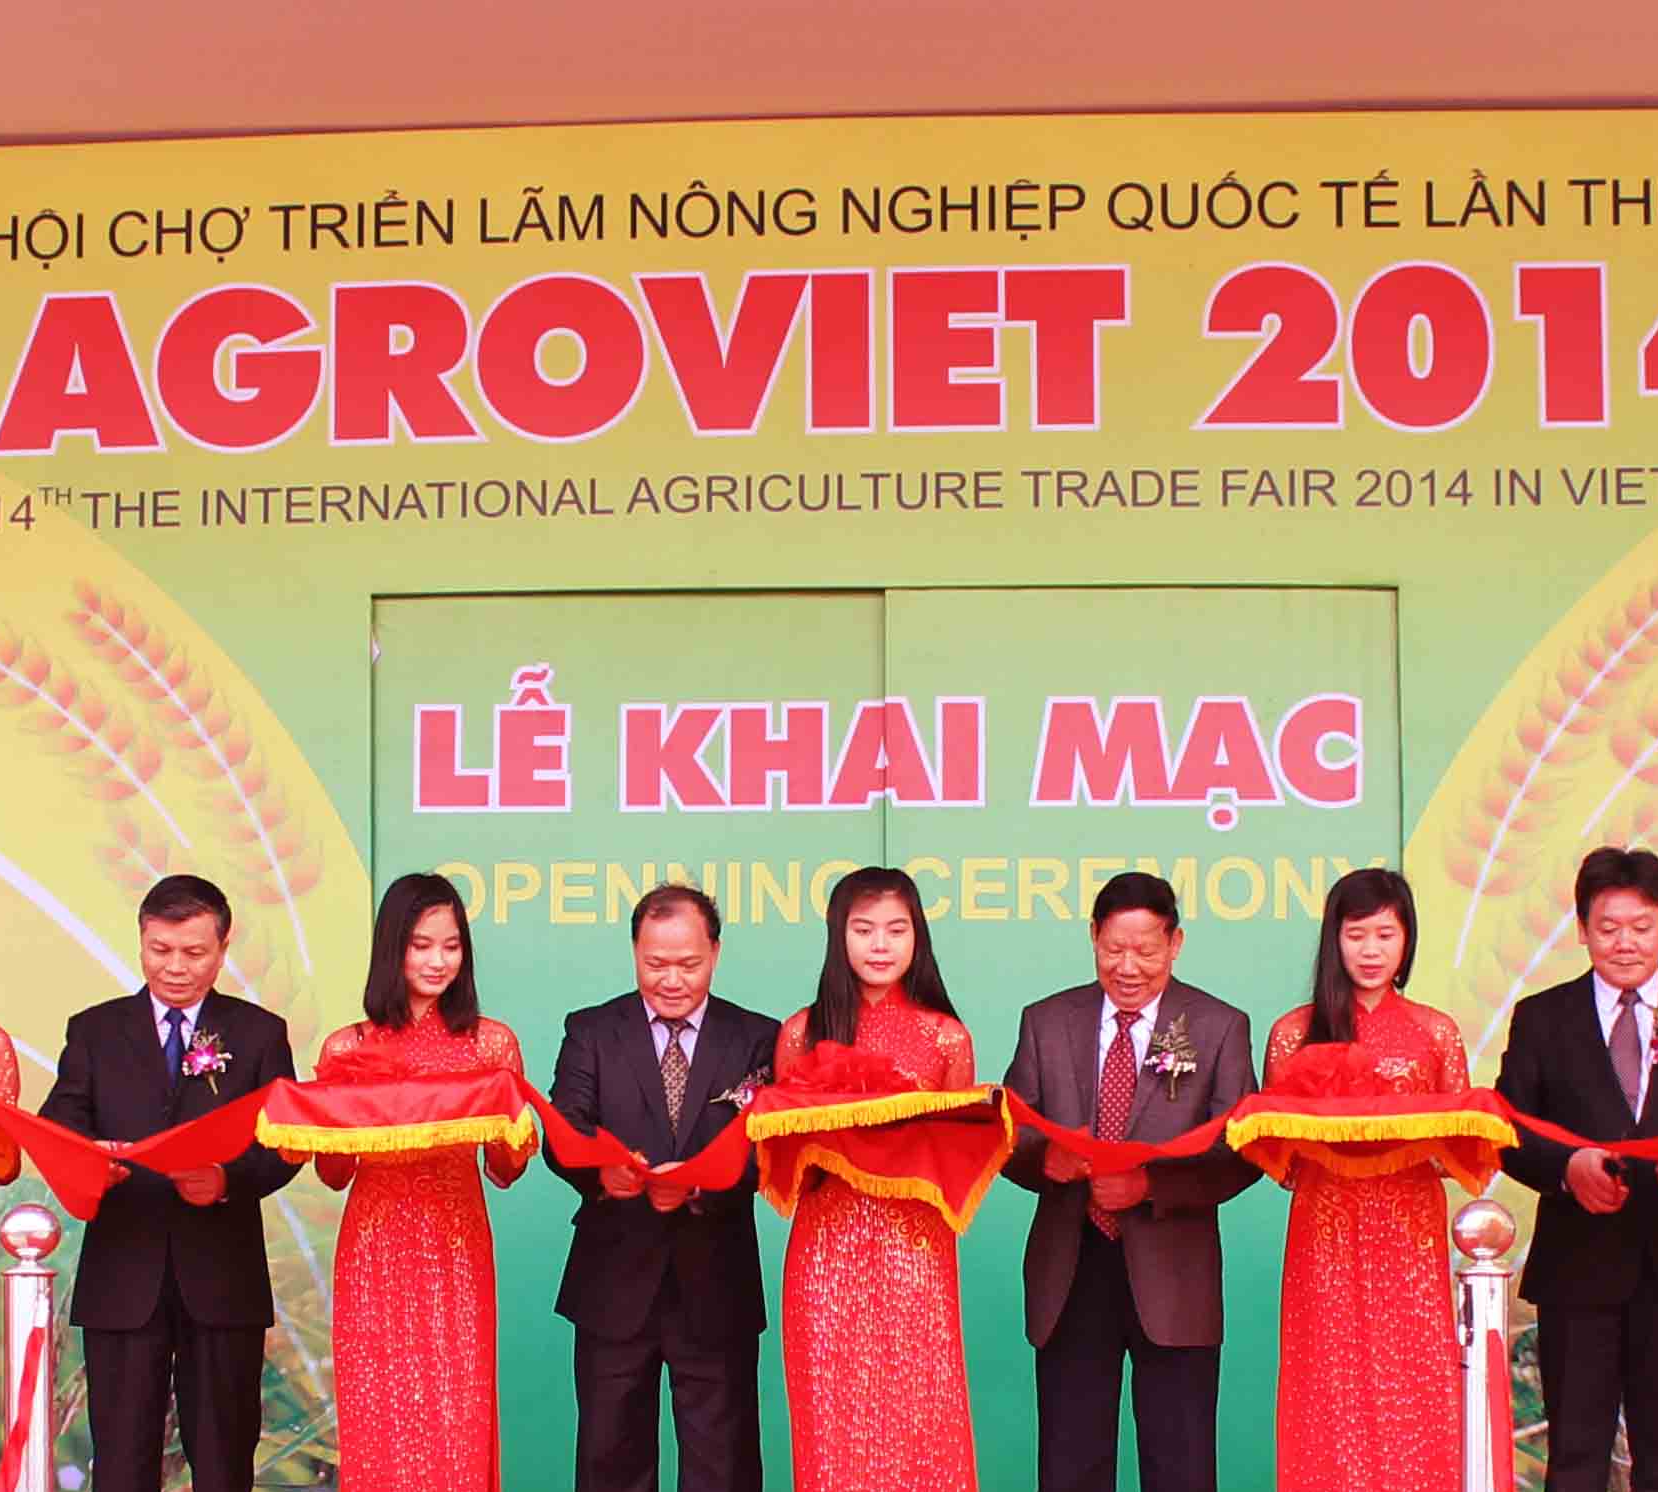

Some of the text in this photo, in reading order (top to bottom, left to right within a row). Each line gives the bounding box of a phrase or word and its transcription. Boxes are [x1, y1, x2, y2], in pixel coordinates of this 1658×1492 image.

[107, 207, 250, 264] CHỢ
[268, 190, 456, 251] TRIỂN
[478, 187, 604, 244] LÃM
[629, 180, 817, 239] NÔNG
[841, 179, 1086, 242] NGHIỆP
[1106, 171, 1299, 232] QUỐC
[1319, 170, 1400, 228] TẾ
[1425, 169, 1547, 228] LẦN
[82, 488, 181, 530] THE
[200, 477, 613, 527] INTERNATIONAL
[626, 470, 1003, 514] AGRICULTURE
[1021, 468, 1202, 510] TRADE
[1221, 468, 1338, 509] FAIR
[1354, 468, 1472, 509] 2014
[1492, 467, 1542, 507] IN
[414, 661, 1363, 832] LỄ KHAI MẠC
